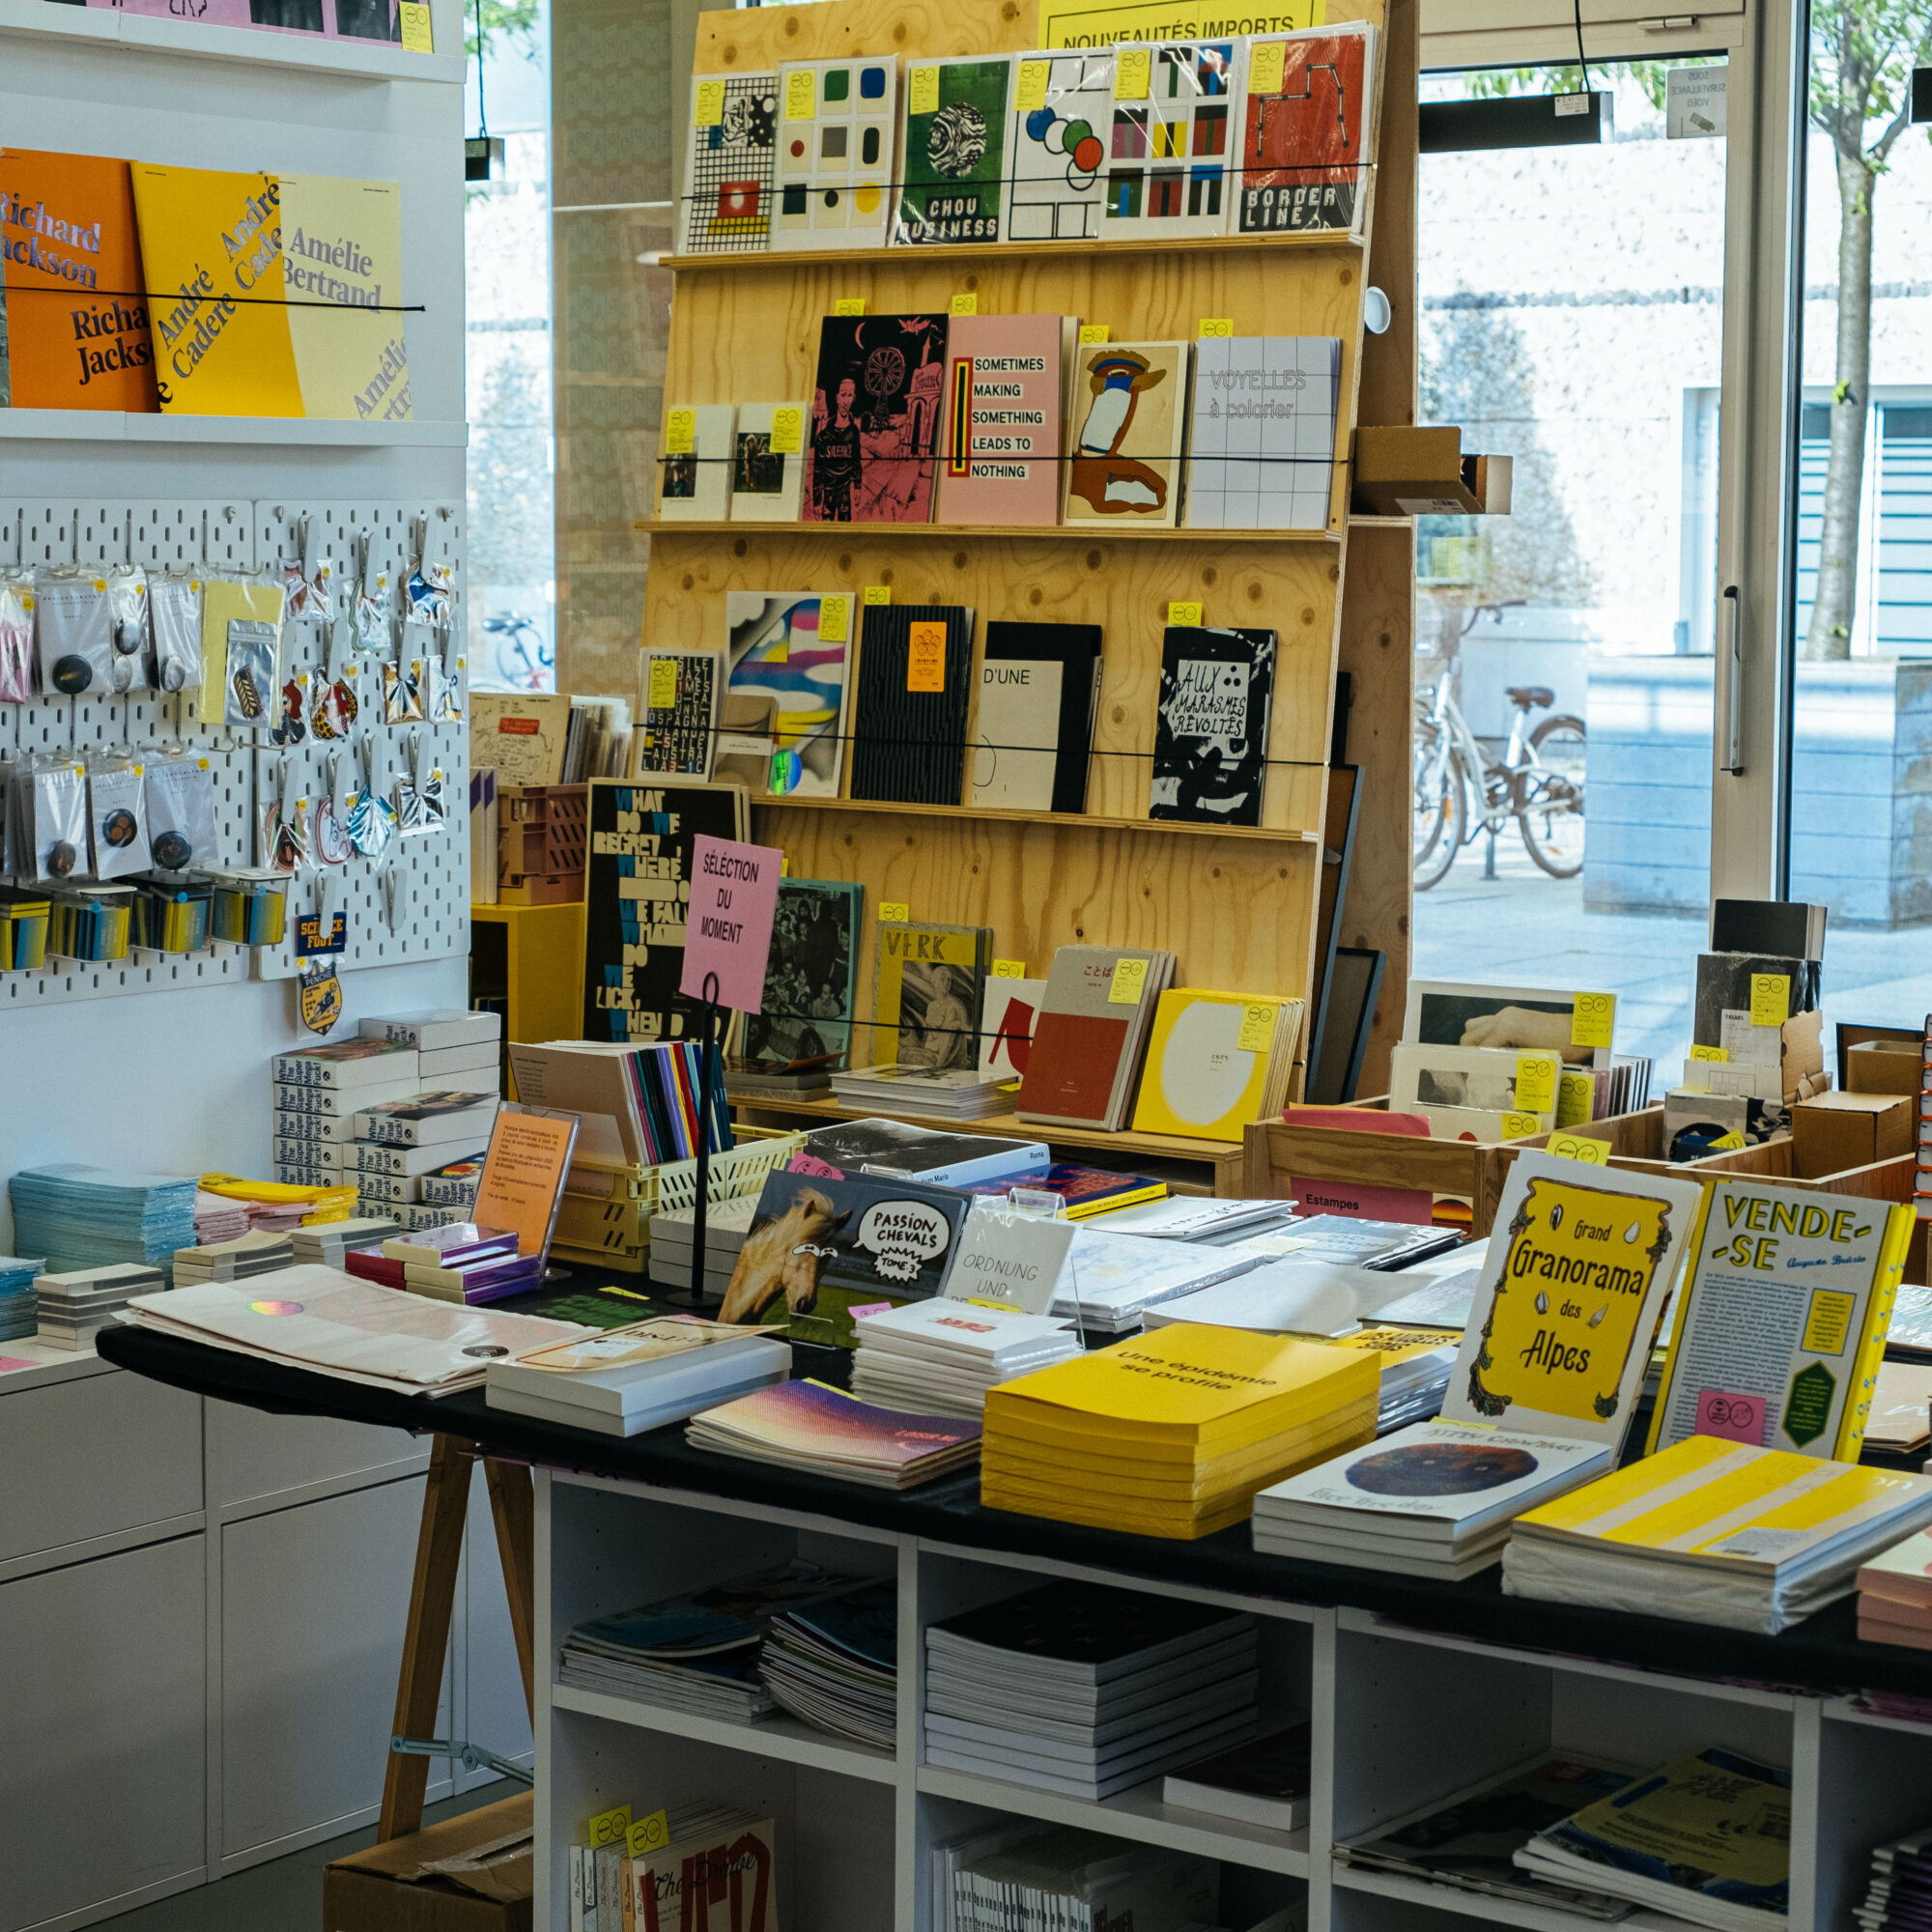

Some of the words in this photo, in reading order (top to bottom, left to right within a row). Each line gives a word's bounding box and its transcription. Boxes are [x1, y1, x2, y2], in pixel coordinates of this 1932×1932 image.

[1064, 19, 1197, 48] NOUVEAUTÉS
[1203, 15, 1294, 38] IMPORTS
[928, 197, 979, 217] CHOU
[1246, 187, 1337, 208] BORDER
[0, 191, 100, 254] Richard
[221, 176, 280, 263] André
[900, 217, 999, 240] BUSINESS
[1244, 208, 1303, 227] LINE
[2, 236, 97, 289] ackson
[234, 224, 283, 291] Cade
[290, 227, 373, 276] Amélie
[282, 256, 382, 314] Bertrand
[156, 263, 213, 350] André
[70, 300, 151, 340] Richa
[172, 293, 237, 379] Cadere
[77, 337, 155, 385] Jacks
[974, 357, 1044, 372] SOMETIMES
[974, 384, 1021, 397] MAKING
[1209, 369, 1307, 390] VOYELLES
[972, 410, 1043, 424] SOMETHING
[1208, 398, 1220, 418] à
[1226, 398, 1293, 419] colorier
[972, 437, 1012, 450] LEADS
[1015, 438, 1032, 450] TO
[971, 465, 1026, 478] NOTHING
[983, 668, 1031, 685] D'UNE
[1178, 664, 1221, 694] AUX
[1175, 694, 1246, 718] MARASMES
[614, 788, 666, 812] WHAT
[617, 810, 641, 833] DO
[593, 831, 661, 856] REGRET
[703, 850, 759, 883] SÉLÉCTION
[717, 888, 732, 910] DU
[301, 919, 344, 935] SCICE
[700, 916, 744, 944] MOMENT
[884, 930, 946, 960] VERK
[278, 1059, 287, 1082] What
[304, 1061, 313, 1084] Mega
[313, 1062, 322, 1086] Fuck!
[296, 1088, 304, 1111] Super
[305, 1089, 314, 1111] Mega
[304, 1116, 314, 1138] Mega
[368, 1117, 377, 1139] What
[394, 1120, 403, 1144] Fuck!
[304, 1142, 314, 1165] Mega
[383, 1150, 391, 1173] Fuck!
[383, 1177, 391, 1200] Fuck!
[458, 1182, 467, 1204] Mega
[1305, 1194, 1359, 1210] Estampes
[1723, 1194, 1872, 1243] VENDE-
[877, 1229, 937, 1249] CHEVALS
[1574, 1219, 1612, 1242] Grand
[963, 1254, 1038, 1281] ORDNUNG
[1512, 1239, 1644, 1296] Granorama
[977, 1279, 1008, 1297] UND
[1560, 1298, 1581, 1319] des
[1520, 1329, 1591, 1375] Alpes
[1117, 1350, 1165, 1365] Une
[1169, 1358, 1277, 1387] épidémie
[1121, 1363, 1151, 1374] se
[1153, 1368, 1233, 1392] profile
